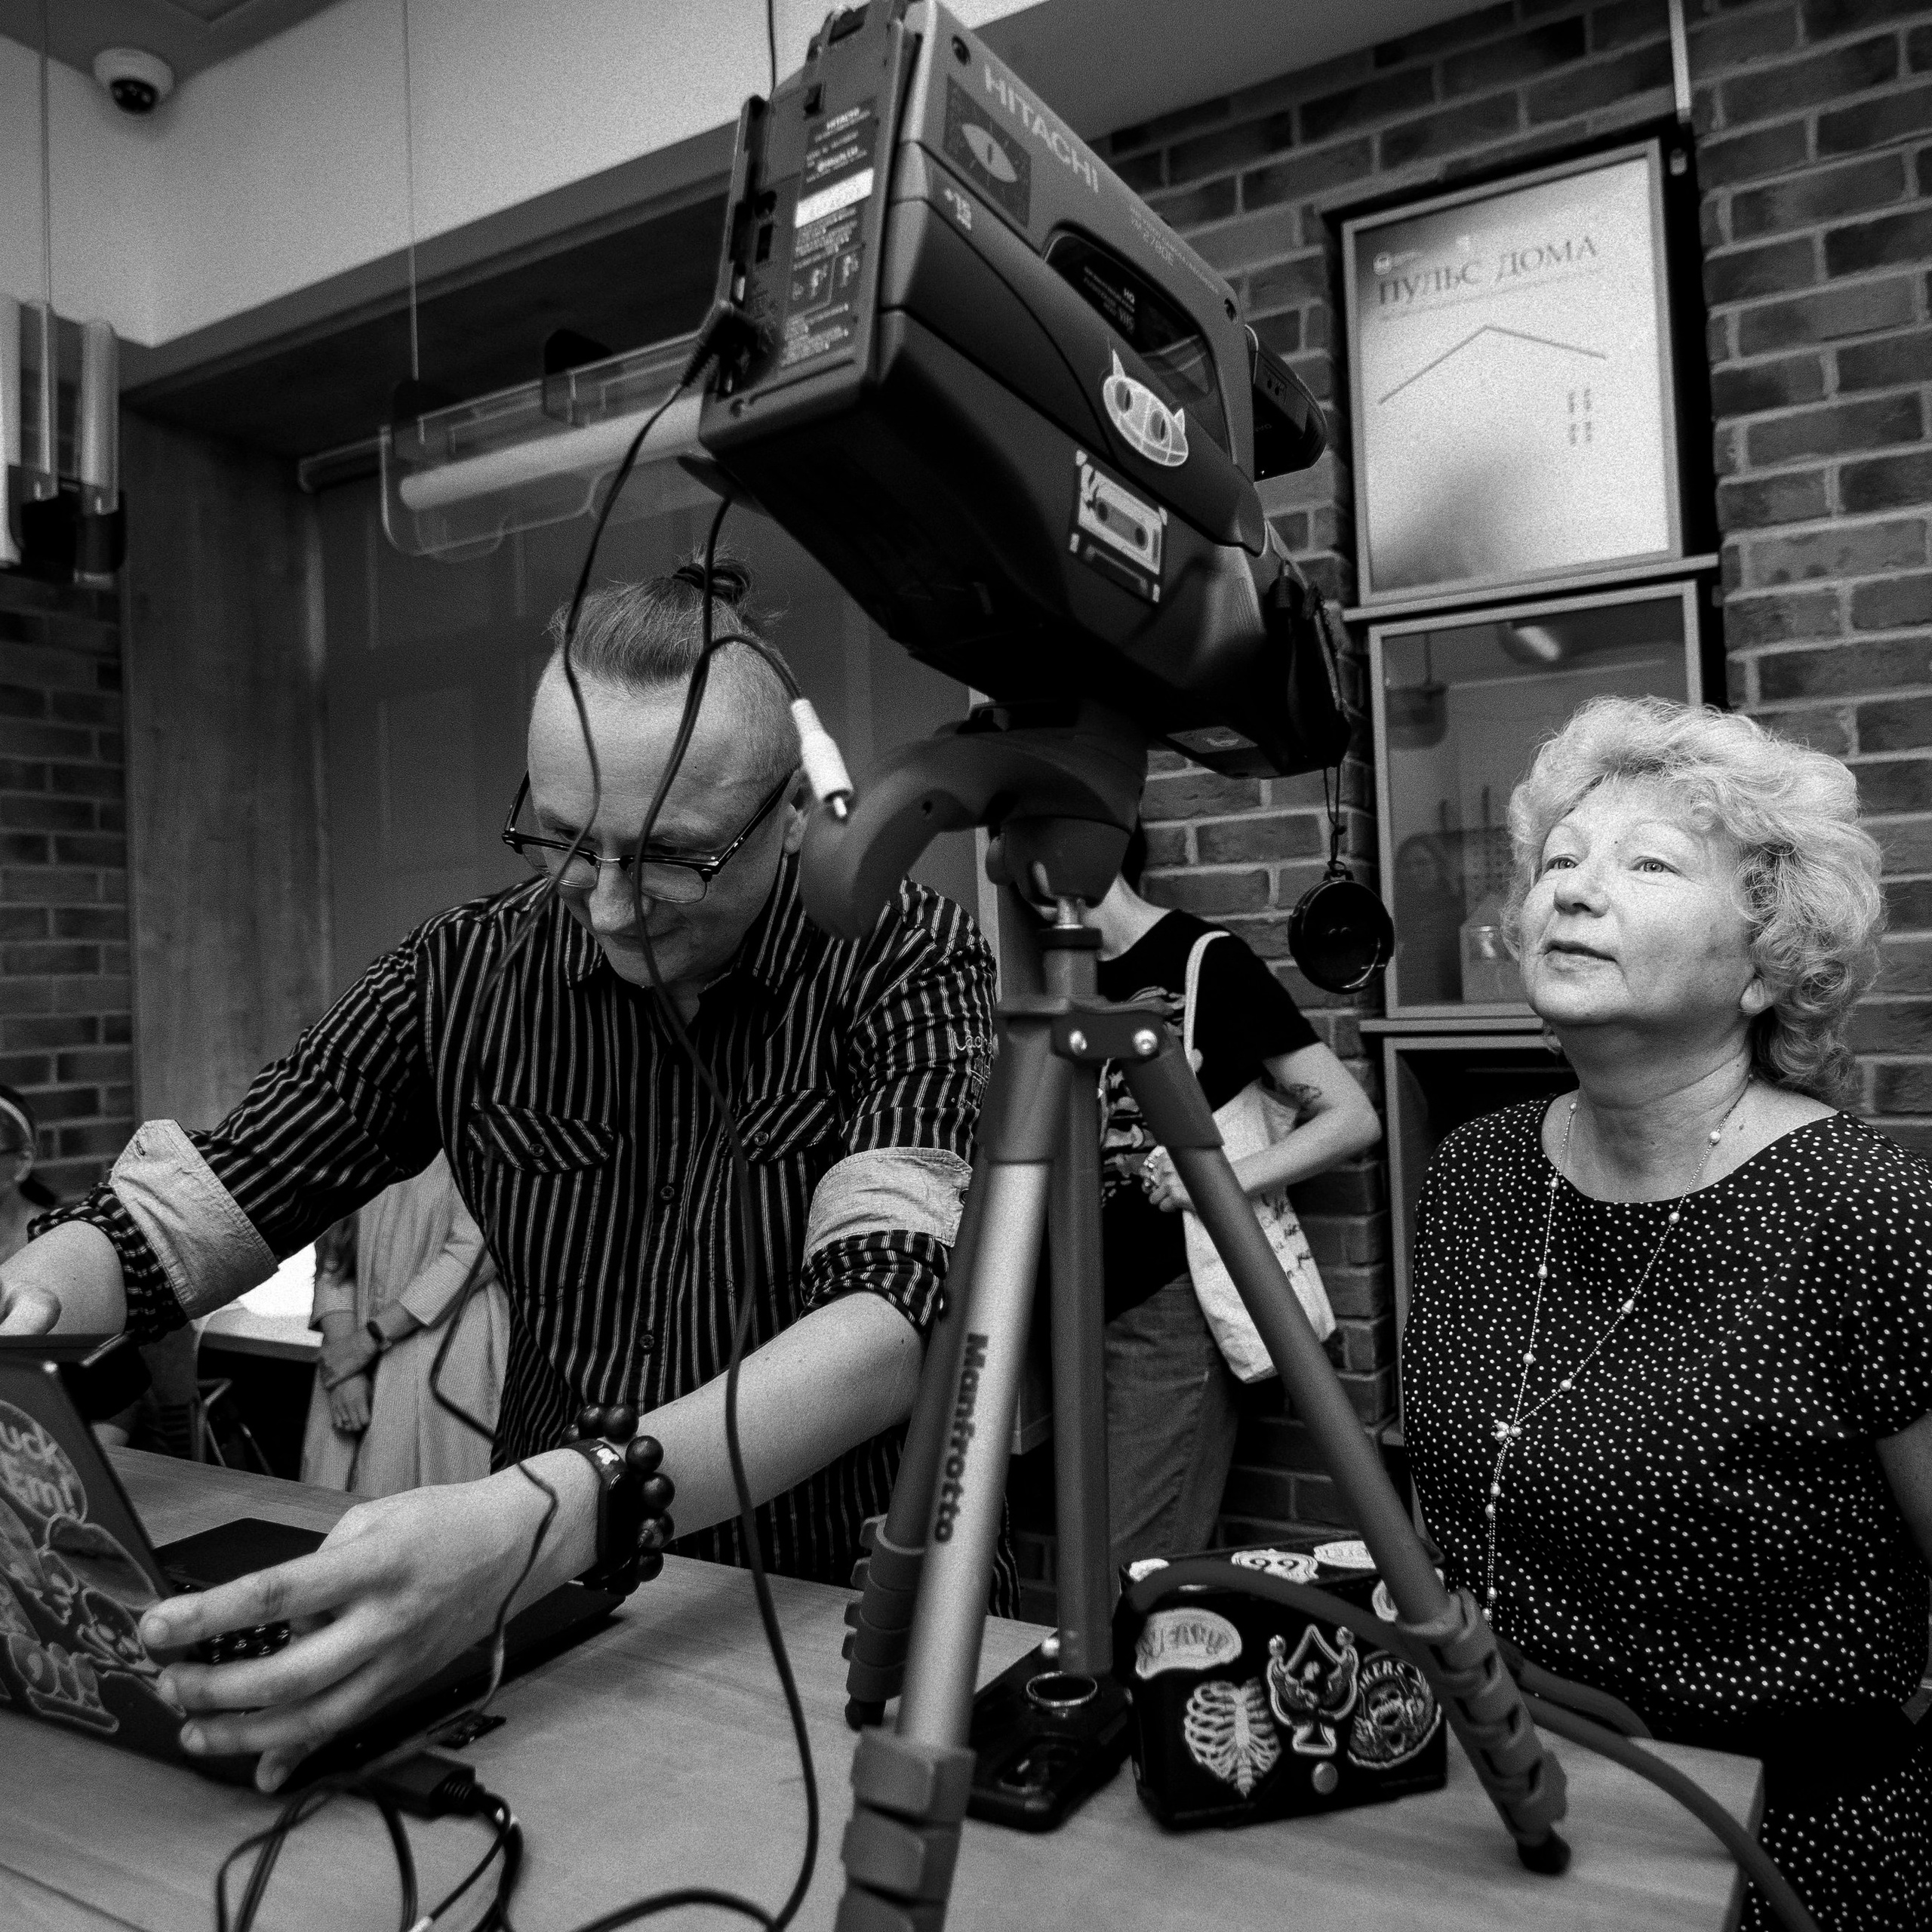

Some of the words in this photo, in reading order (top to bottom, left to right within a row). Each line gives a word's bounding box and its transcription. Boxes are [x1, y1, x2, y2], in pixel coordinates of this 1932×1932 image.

[983, 63, 1098, 193] HITACHI
[1379, 260, 1482, 304] ПУЛЬС
[1495, 235, 1598, 282] ДОМА
[934, 1332, 989, 1543] Manfrotto
